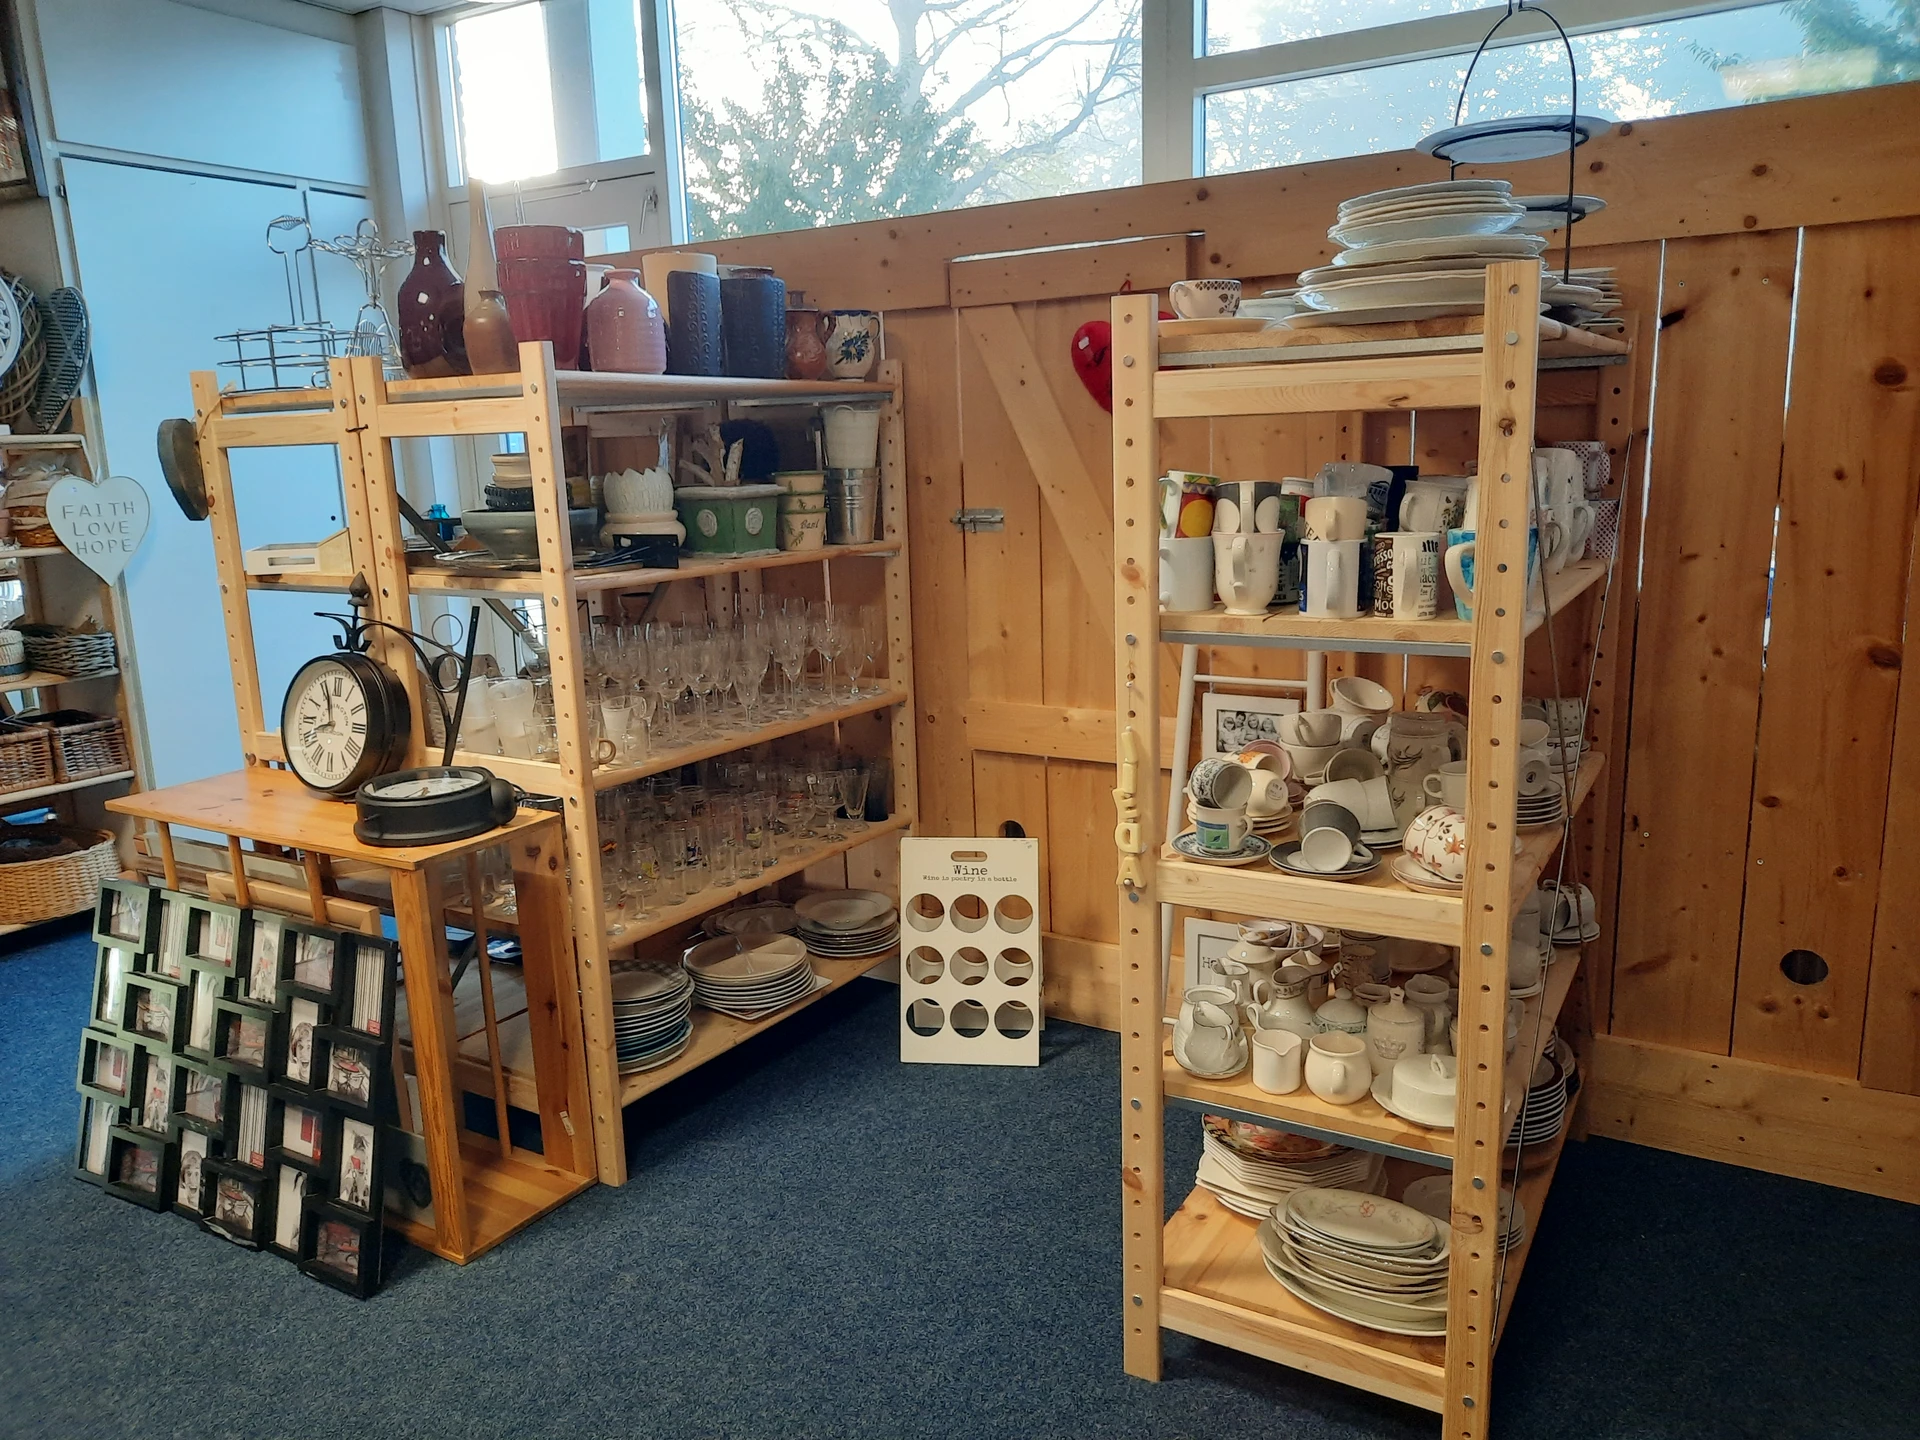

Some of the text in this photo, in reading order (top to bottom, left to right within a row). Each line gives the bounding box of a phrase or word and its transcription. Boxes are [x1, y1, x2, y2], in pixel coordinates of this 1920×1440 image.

[62, 501, 135, 520] FAITH
[72, 520, 130, 537] LOVE
[75, 538, 133, 555] HOPE
[320, 702, 348, 727] KENINGTON
[953, 865, 988, 875] Wine
